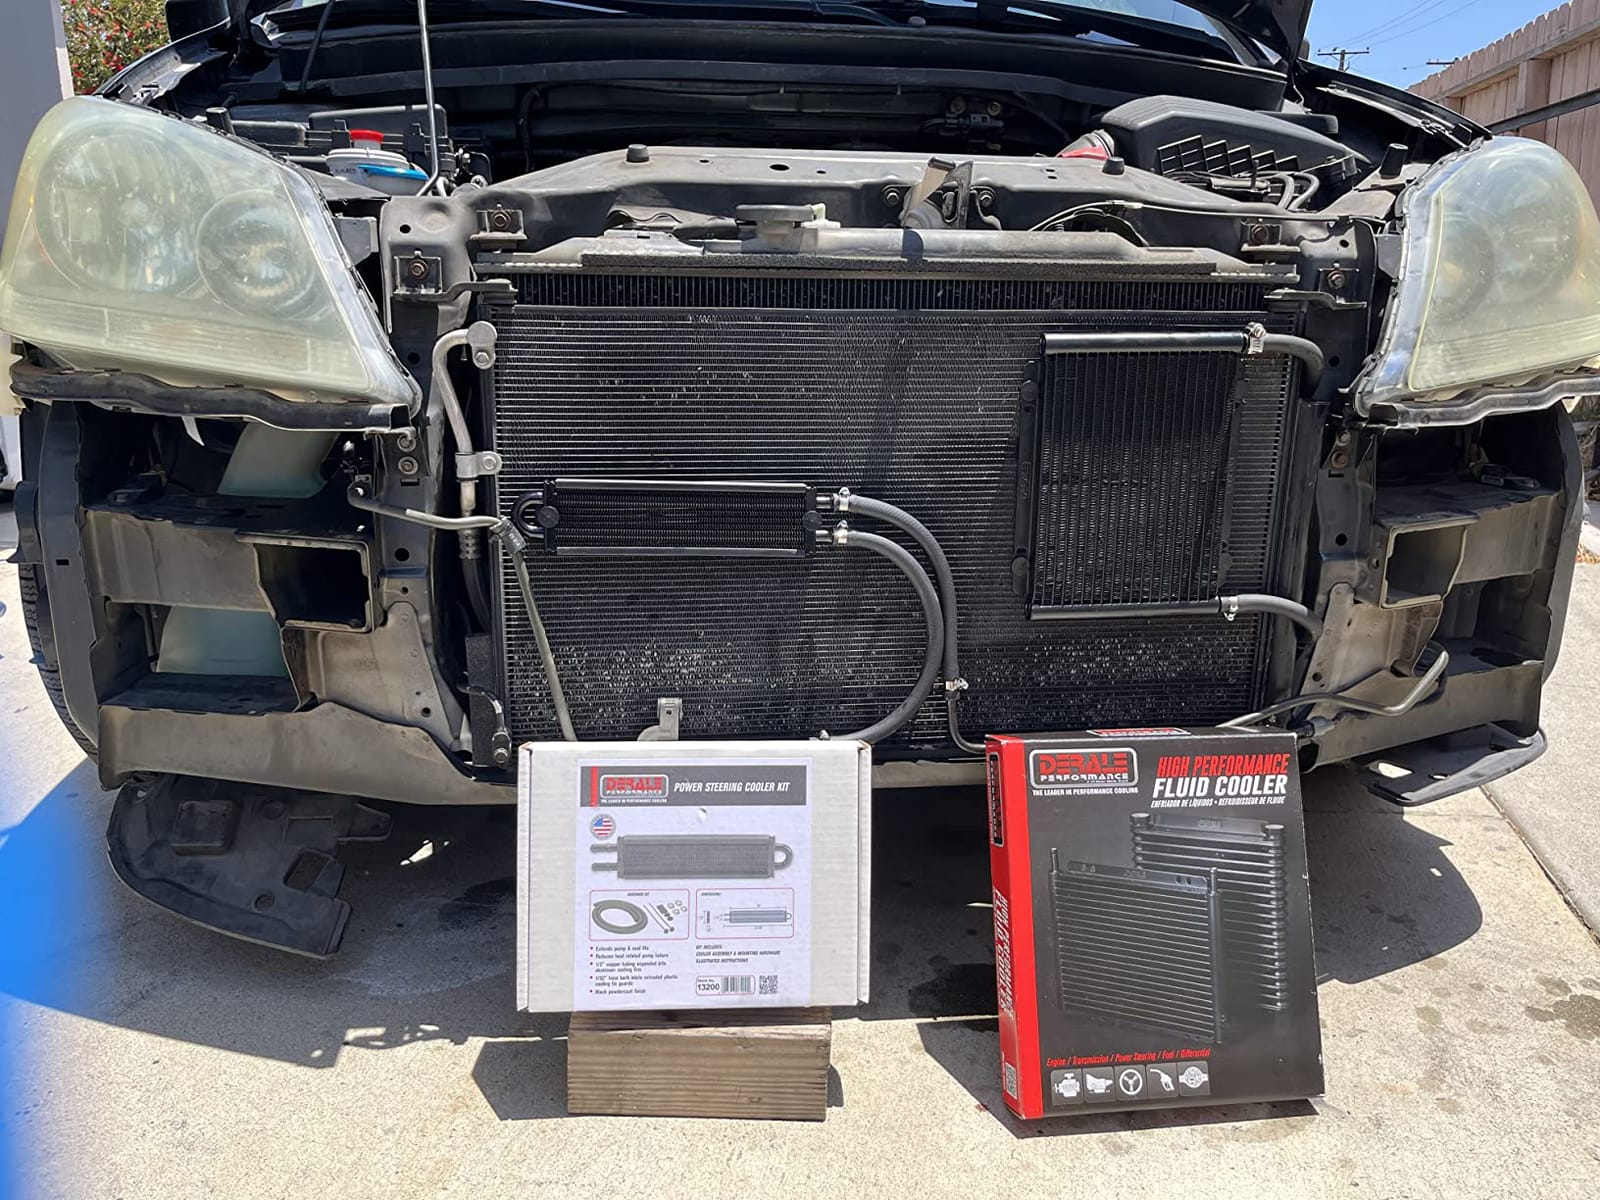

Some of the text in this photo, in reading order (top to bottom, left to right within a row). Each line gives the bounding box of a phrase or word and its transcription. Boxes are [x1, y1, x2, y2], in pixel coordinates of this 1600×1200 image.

[1038, 752, 1128, 774] DERALE
[1156, 754, 1290, 778] HIGH PERFORMANCE
[606, 777, 663, 790] DERALE
[674, 782, 790, 792] POWER STEERING COOLER KIT
[1040, 772, 1128, 782] PERFORMANCE
[1152, 774, 1288, 798] FLUID COOLER
[996, 889, 1004, 940] FLUID
[1046, 1057, 1066, 1068] Engine
[1115, 1053, 1132, 1062] Power
[1162, 1050, 1174, 1059] Fuel
